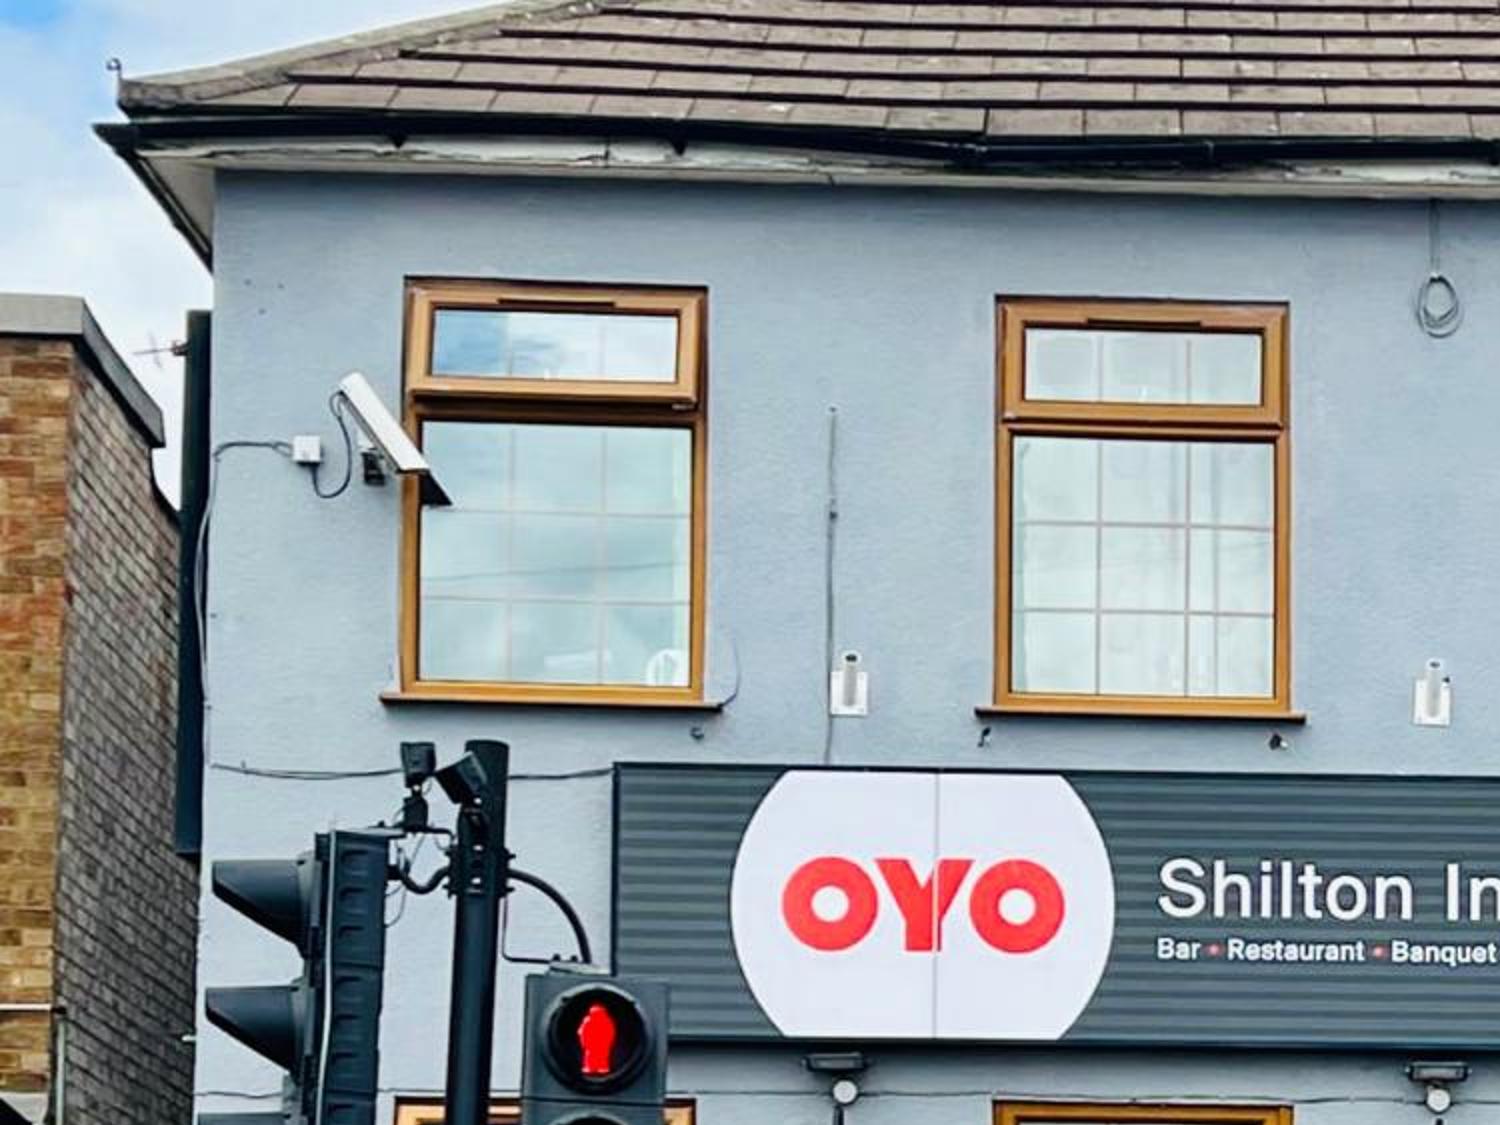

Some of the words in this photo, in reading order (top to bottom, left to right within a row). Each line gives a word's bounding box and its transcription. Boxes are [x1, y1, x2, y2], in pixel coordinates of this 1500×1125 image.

[782, 856, 1065, 953] OYO
[1157, 856, 1414, 922] Shilton
[1156, 937, 1201, 961] Bar
[1226, 938, 1365, 962] Restaurant
[1390, 940, 1497, 968] Banquet
